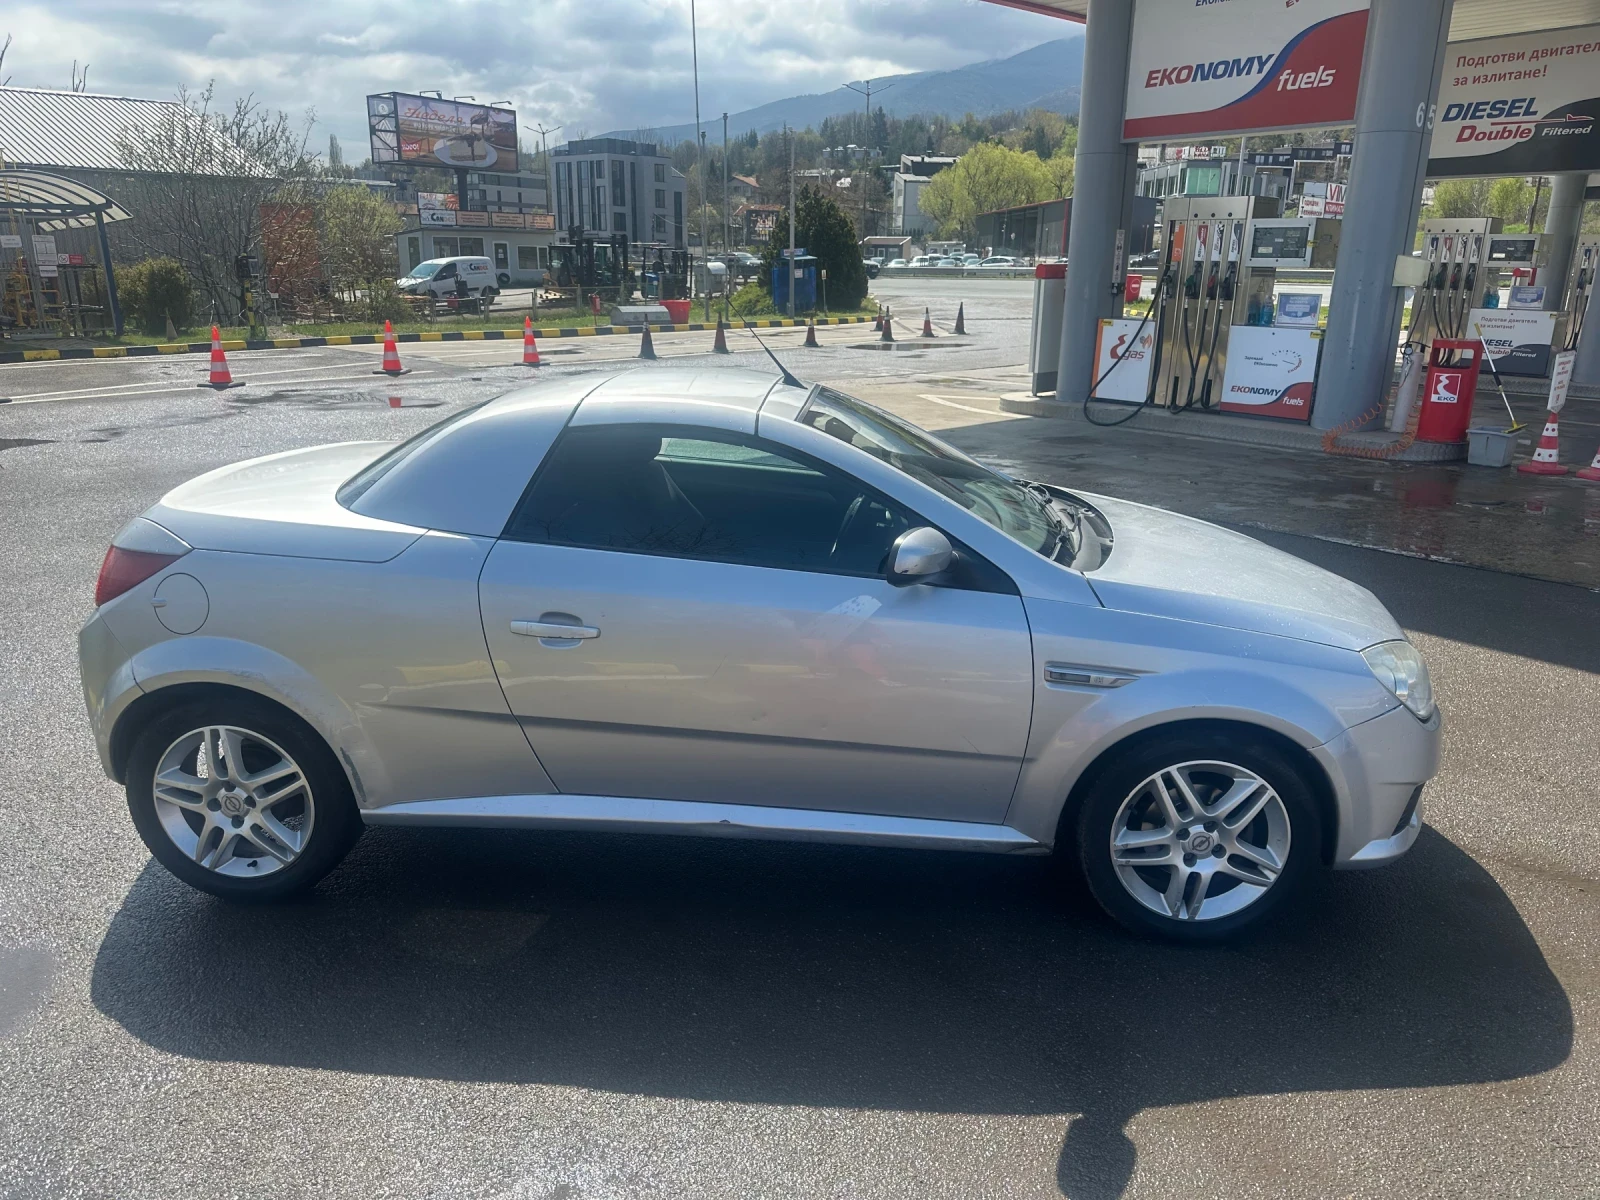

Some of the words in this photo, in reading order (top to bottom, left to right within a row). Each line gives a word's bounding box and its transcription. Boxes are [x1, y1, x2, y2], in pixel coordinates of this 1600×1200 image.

[1456, 50, 1526, 68] Подготви
[1144, 53, 1275, 89] EKONOMY
[1276, 65, 1336, 92] fuels
[1452, 76, 1468, 87] за
[1472, 65, 1548, 85] излитане!
[1441, 97, 1538, 122] DIESEL
[1455, 124, 1533, 143] Double
[1541, 125, 1592, 136] Filtered
[1230, 385, 1282, 397] EKONOMY
[1282, 396, 1305, 406] fuels
